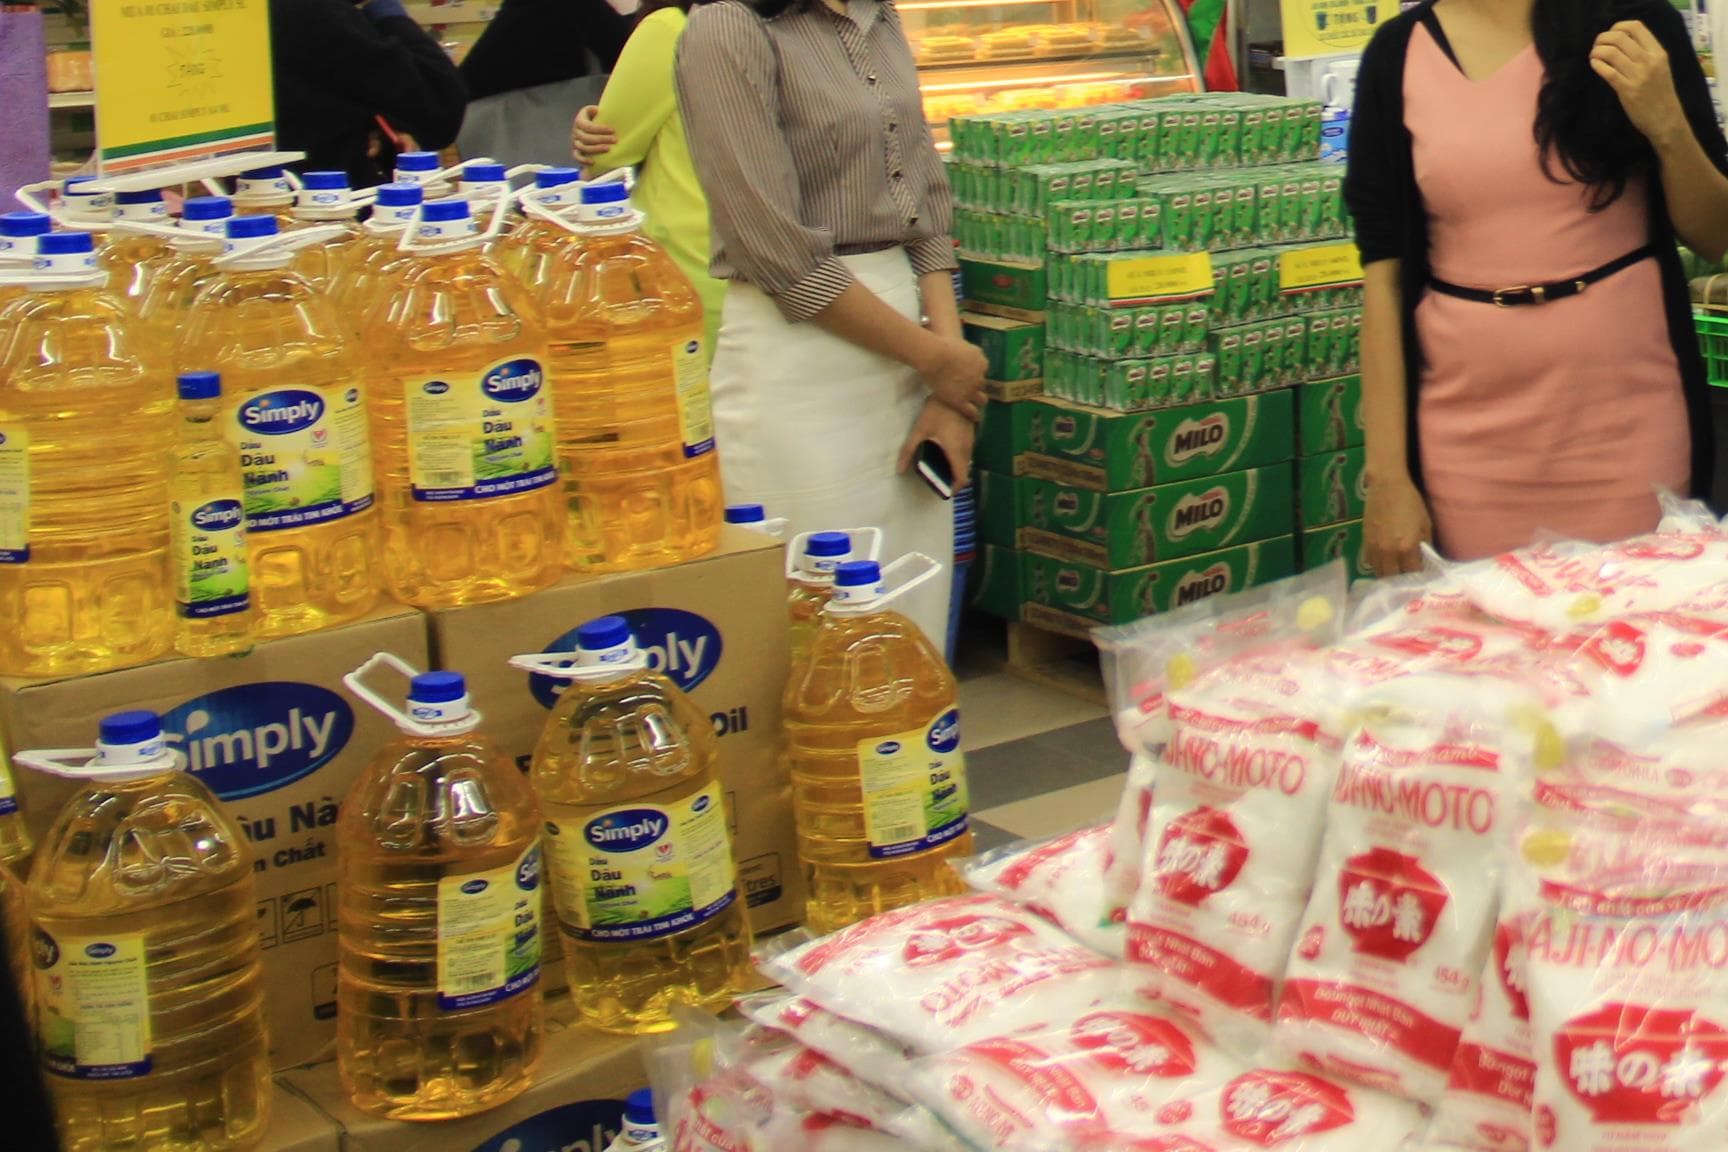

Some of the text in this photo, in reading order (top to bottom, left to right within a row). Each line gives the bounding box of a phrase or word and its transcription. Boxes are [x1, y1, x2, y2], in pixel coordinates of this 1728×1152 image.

[488, 366, 541, 392] Simply
[245, 399, 320, 426] Simply
[1174, 424, 1223, 454] MILO
[1175, 498, 1223, 530] MILO
[1178, 573, 1226, 605] MILO
[162, 707, 337, 772] Simply
[289, 795, 340, 834] Nà
[590, 818, 663, 843] Simply
